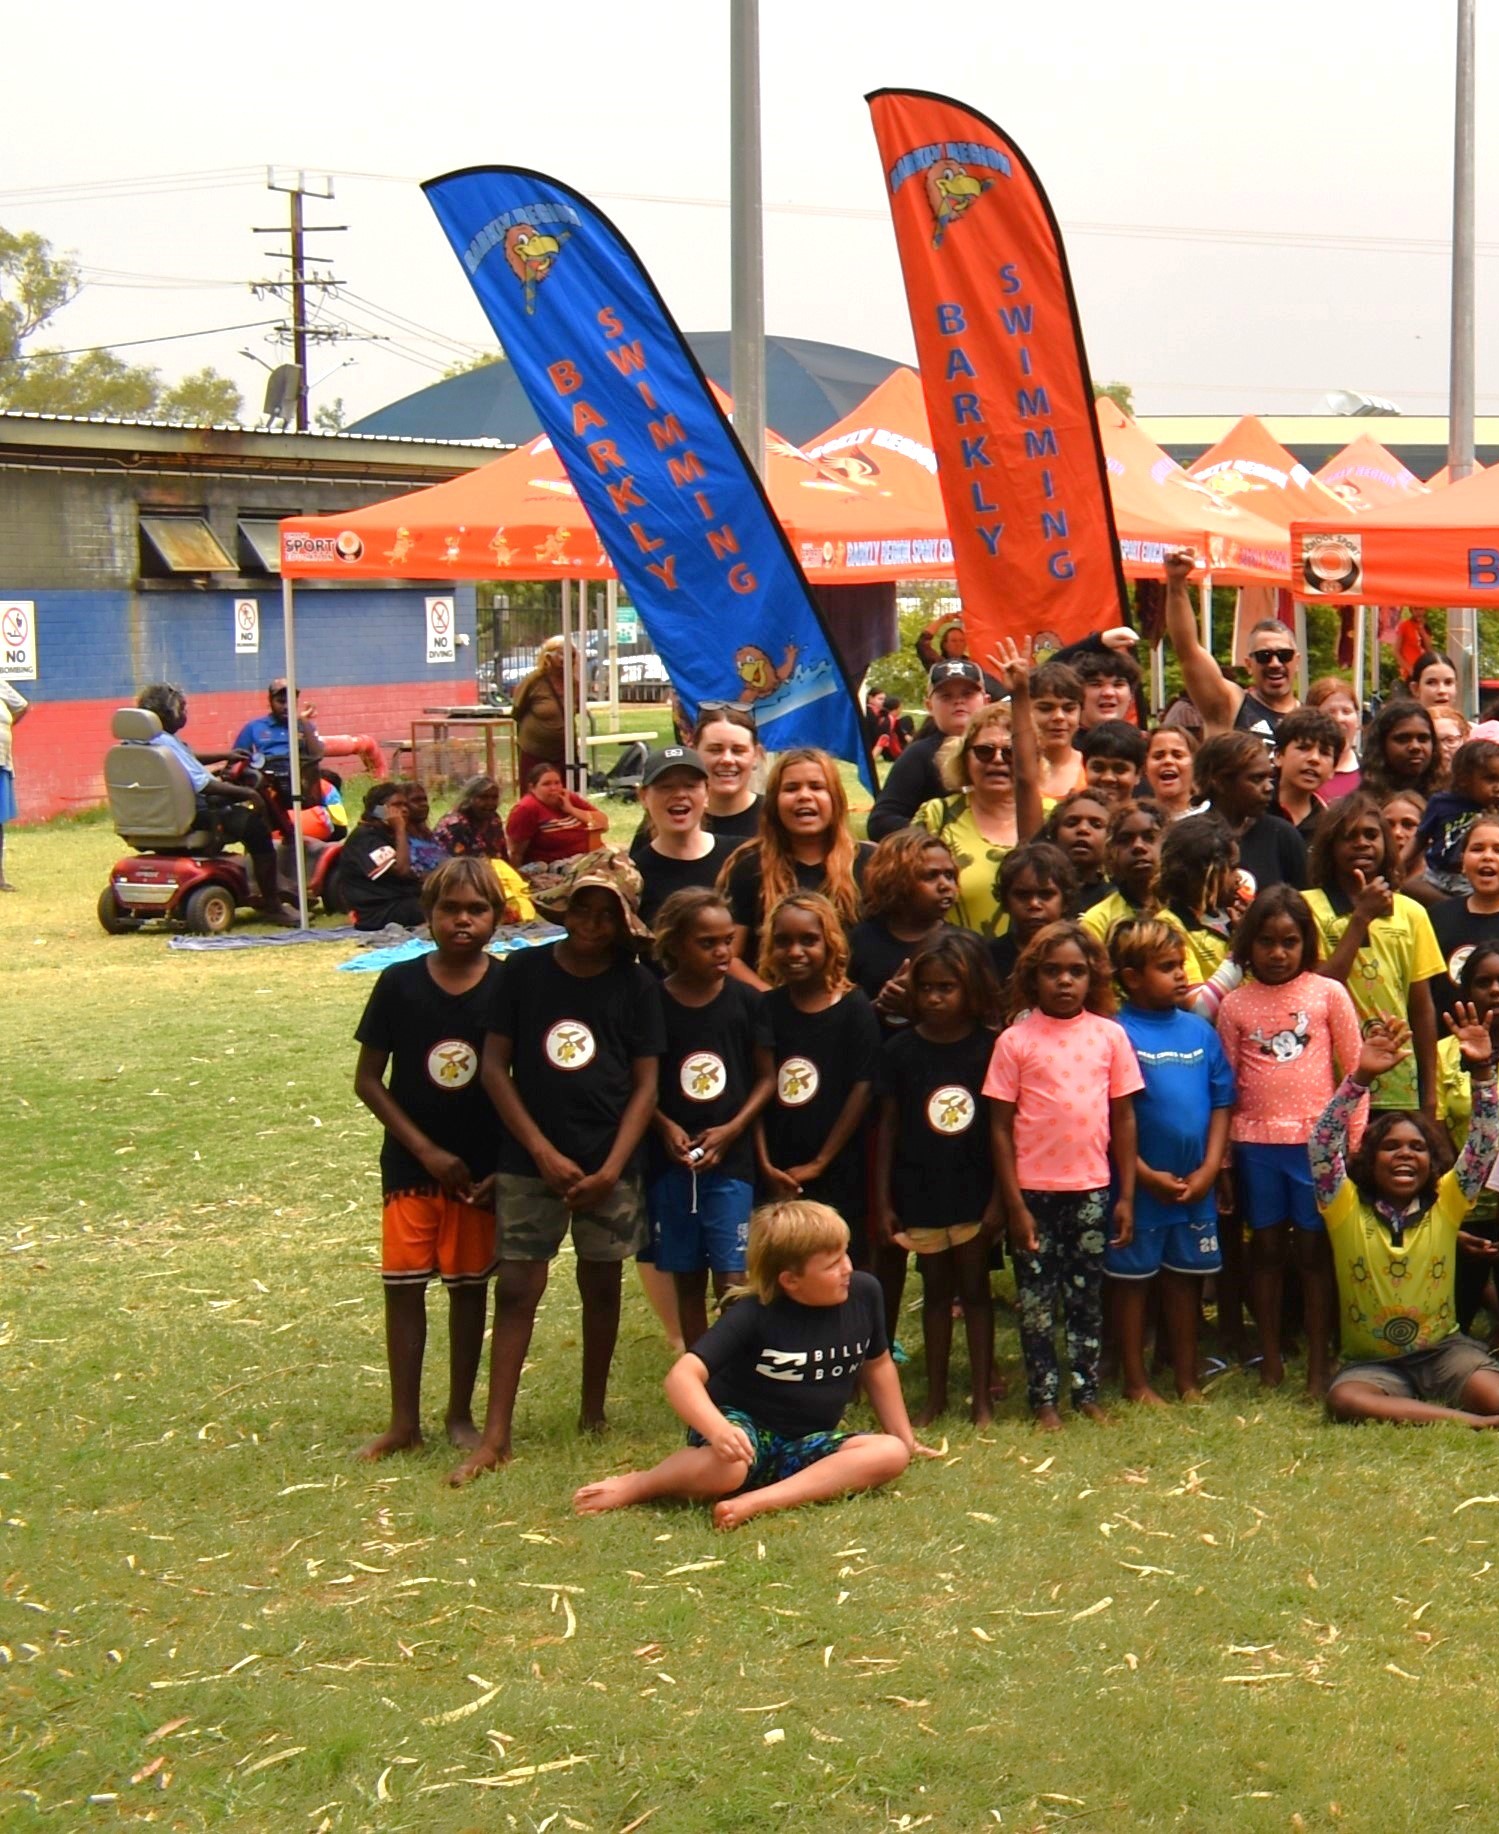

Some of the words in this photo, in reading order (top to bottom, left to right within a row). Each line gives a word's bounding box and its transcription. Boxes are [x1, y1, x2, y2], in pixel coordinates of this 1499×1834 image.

[890, 143, 944, 194] BARKLY
[945, 141, 1013, 179] REGION
[936, 303, 1005, 557] BARKLY
[999, 263, 1075, 582] SWIMMING
[597, 306, 758, 596] SWIMMING
[546, 361, 679, 593] BARKLY
[285, 539, 334, 553] SPORT
[1336, 535, 1361, 556] SPORT
[241, 632, 254, 641] NO
[434, 637, 448, 648] NO
[6, 650, 26, 663] NO
[429, 650, 453, 659] DIVING
